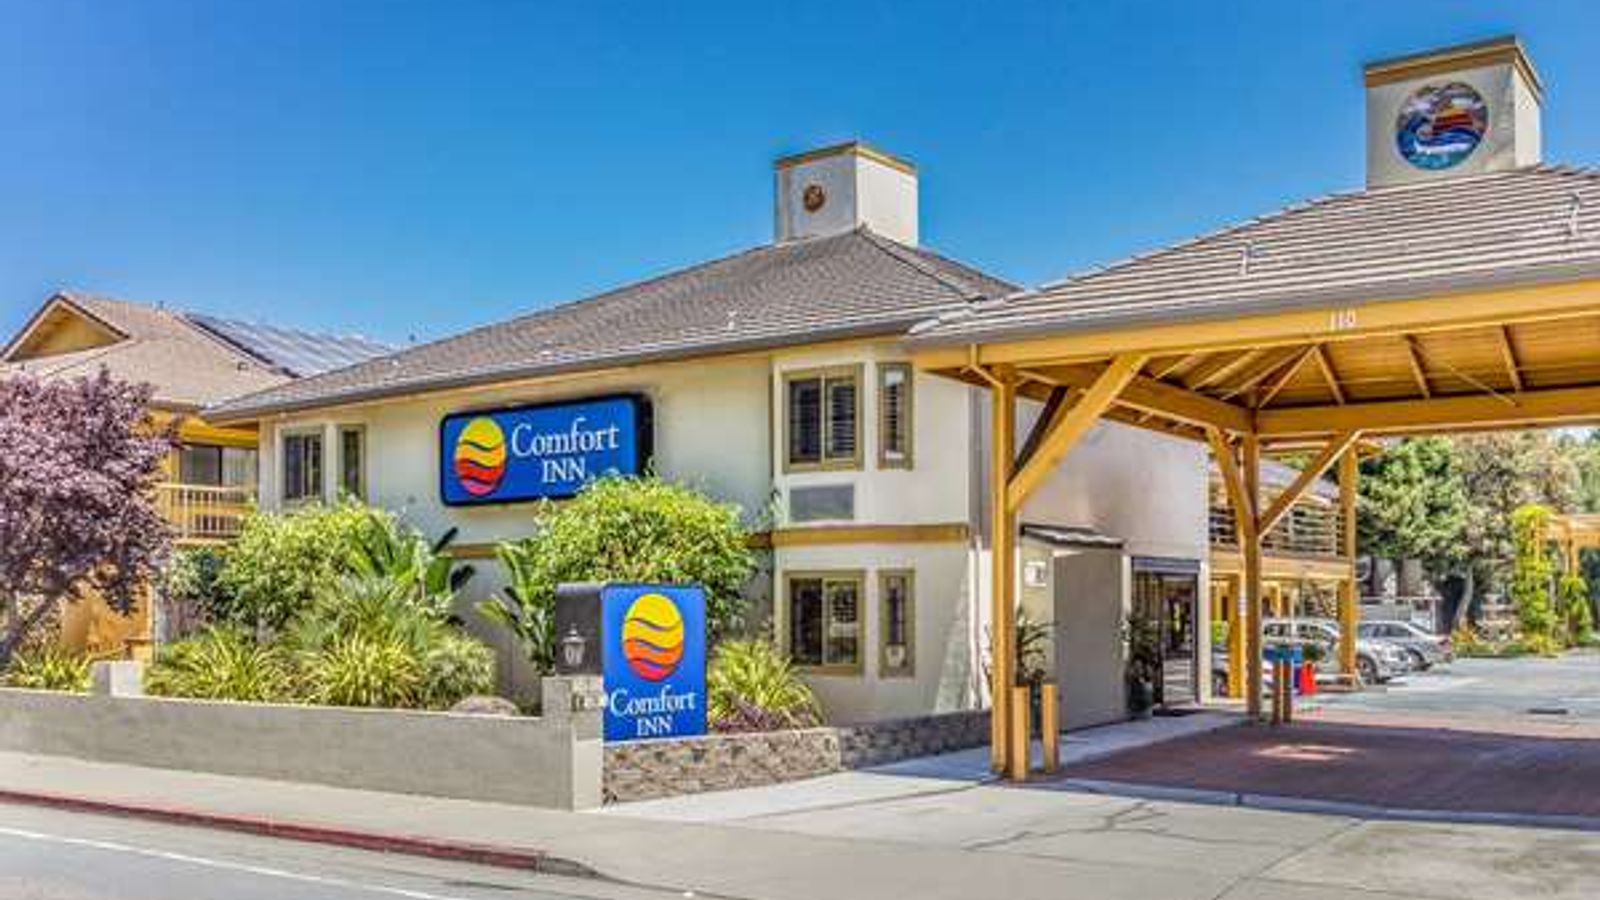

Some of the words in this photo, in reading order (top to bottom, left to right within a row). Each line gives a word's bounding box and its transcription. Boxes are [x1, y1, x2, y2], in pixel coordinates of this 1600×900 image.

[512, 416, 620, 457] Comfort
[542, 456, 586, 483] INN
[610, 684, 697, 717] Comfort
[637, 714, 674, 737] INN
